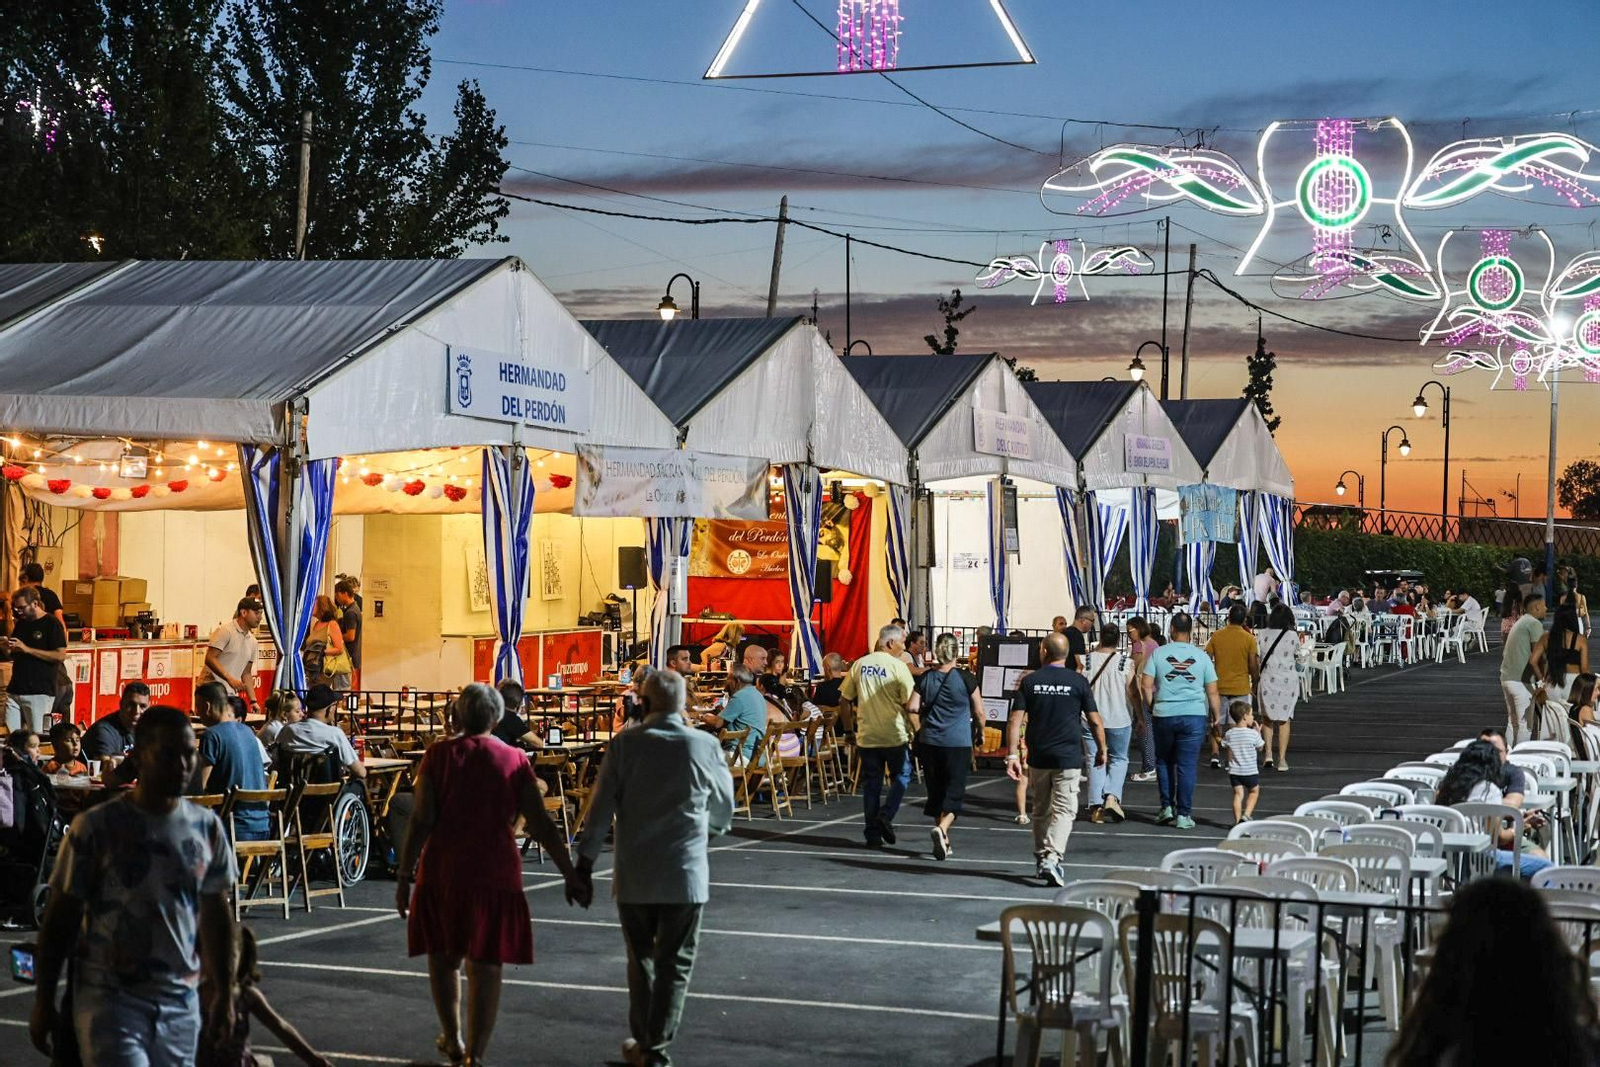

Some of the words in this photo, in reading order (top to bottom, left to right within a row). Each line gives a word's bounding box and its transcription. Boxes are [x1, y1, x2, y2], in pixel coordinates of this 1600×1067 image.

[500, 362, 566, 392] HERMANDAD
[502, 396, 523, 417] DEL
[525, 399, 566, 423] PERDÓN
[606, 461, 656, 478] HERMANDAD
[728, 530, 746, 542] del
[258, 649, 277, 659] TICKETS
[860, 664, 887, 677] PEÑA
[1033, 684, 1072, 692] STAFF
